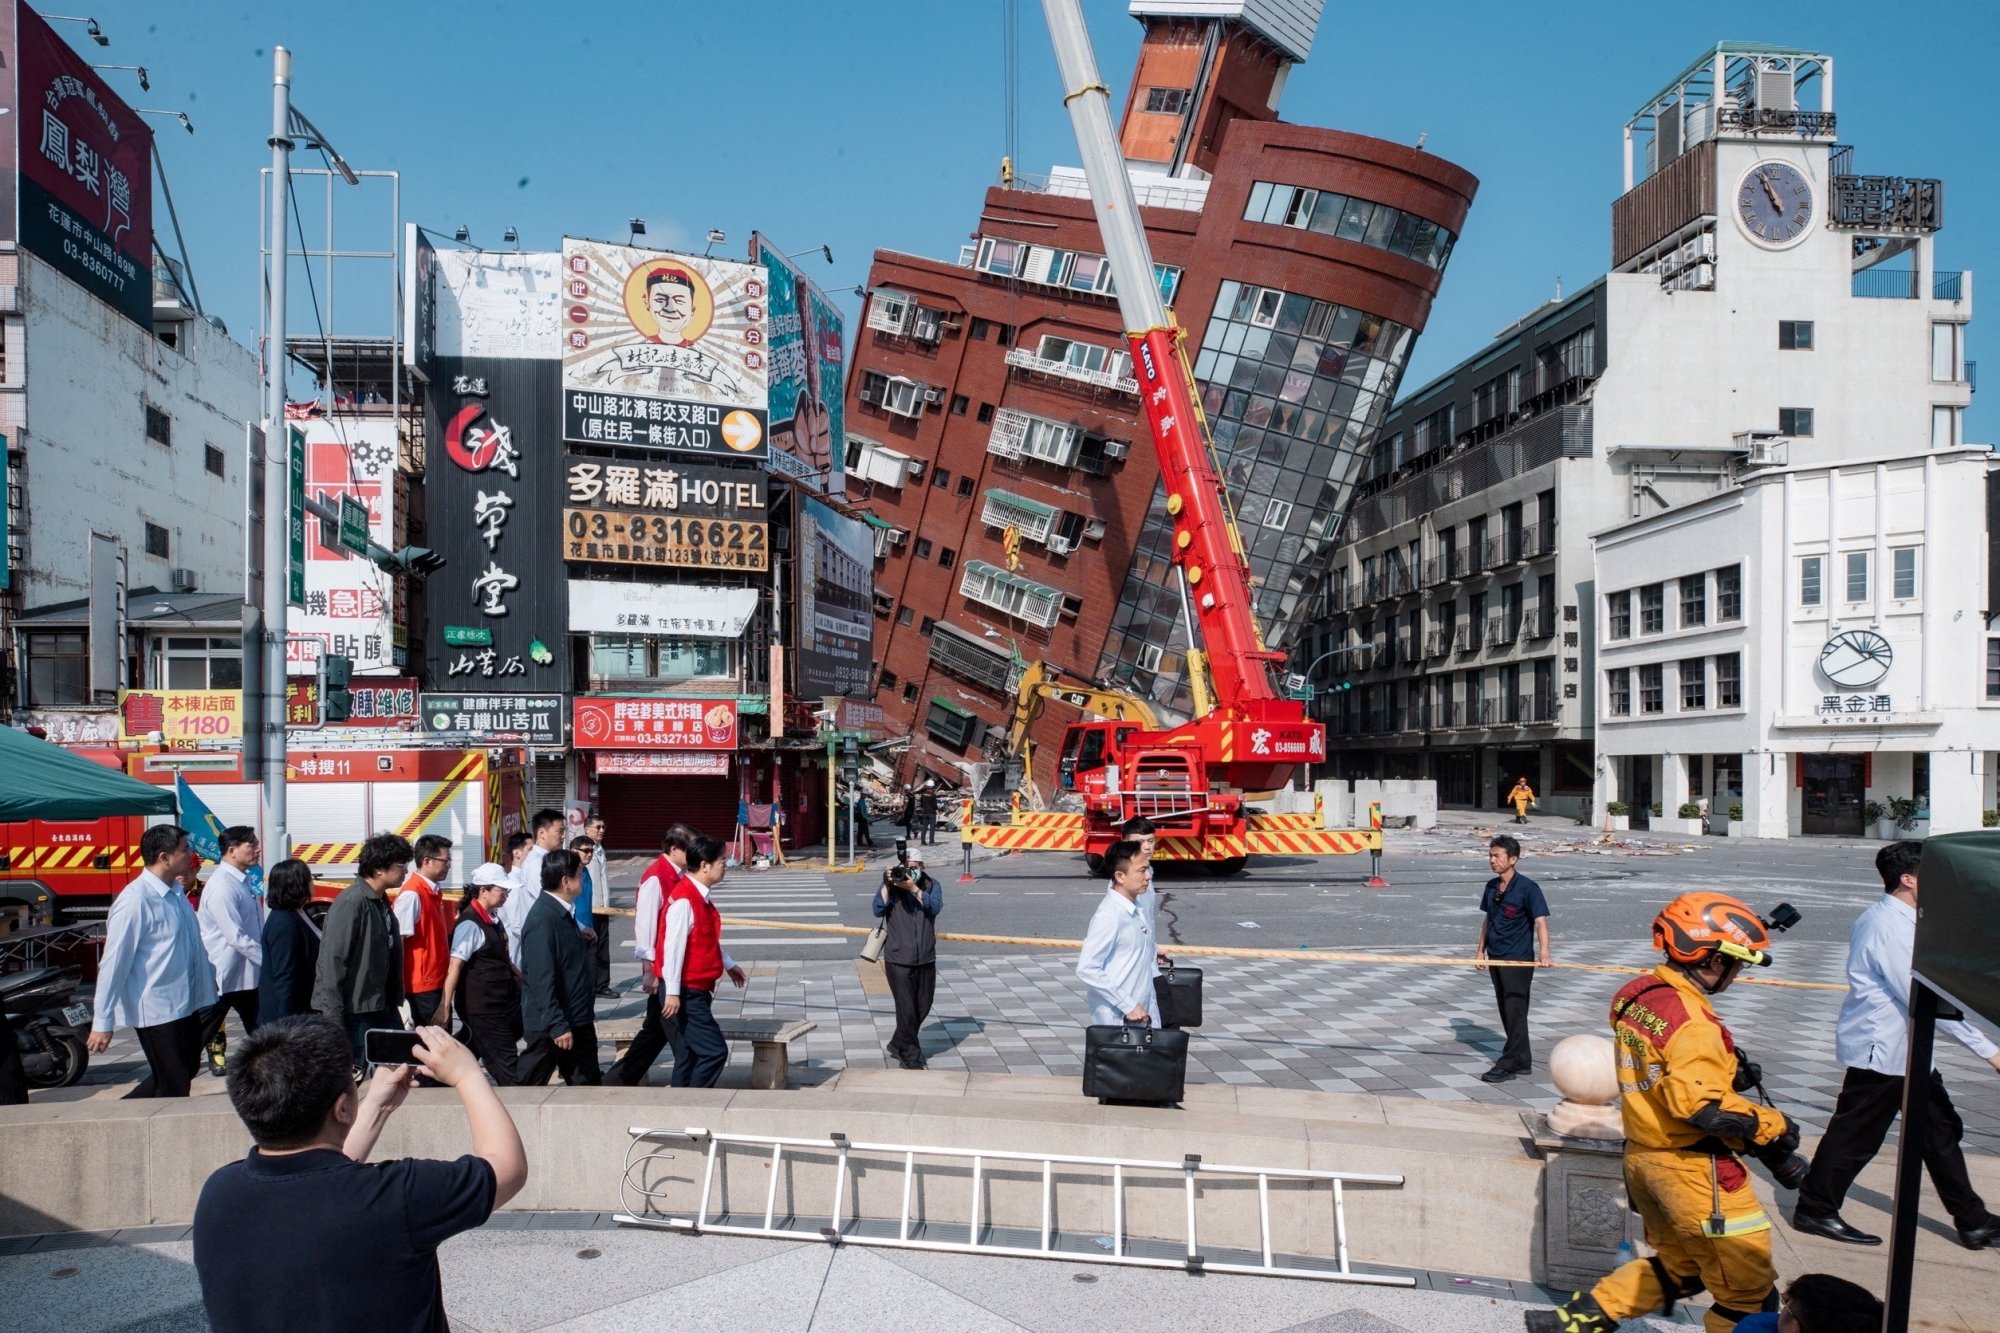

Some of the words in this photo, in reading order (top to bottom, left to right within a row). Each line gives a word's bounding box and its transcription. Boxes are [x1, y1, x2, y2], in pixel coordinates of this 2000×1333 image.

[48, 202, 136, 281] 花蓮市中山路169號
[63, 238, 124, 291] 03-8360777
[572, 257, 588, 346] 僅此一家
[747, 282, 761, 367] 別無分號
[1140, 342, 1156, 380] KATO
[453, 375, 488, 395] 花蓮
[573, 393, 719, 426] 中山路北濱街交叉路口
[581, 417, 711, 449] (原住民一條街入口)
[567, 463, 679, 509] 多羅滿
[681, 478, 765, 508] HOTEL
[293, 456, 302, 543] 中山路
[568, 511, 765, 550] 03-8316622
[616, 613, 651, 627] 多羅滿
[448, 648, 525, 676] 山苦瓜
[168, 695, 235, 712] 本棟店面
[462, 697, 527, 710] 健康伴手禮
[613, 702, 703, 720] 胖老爹美式炸雞
[1070, 693, 1085, 706] CAT
[1820, 694, 1891, 714] 黑金通
[121, 693, 164, 736] 售
[179, 716, 230, 735] 1180
[453, 712, 550, 730] 有機山苦瓜
[637, 733, 703, 744] 03-8327130
[1251, 728, 1272, 754] 宏
[1280, 730, 1302, 739] KATO
[1309, 728, 1323, 754] 威
[301, 760, 350, 775] 特搜11
[611, 753, 646, 767] 石來店
